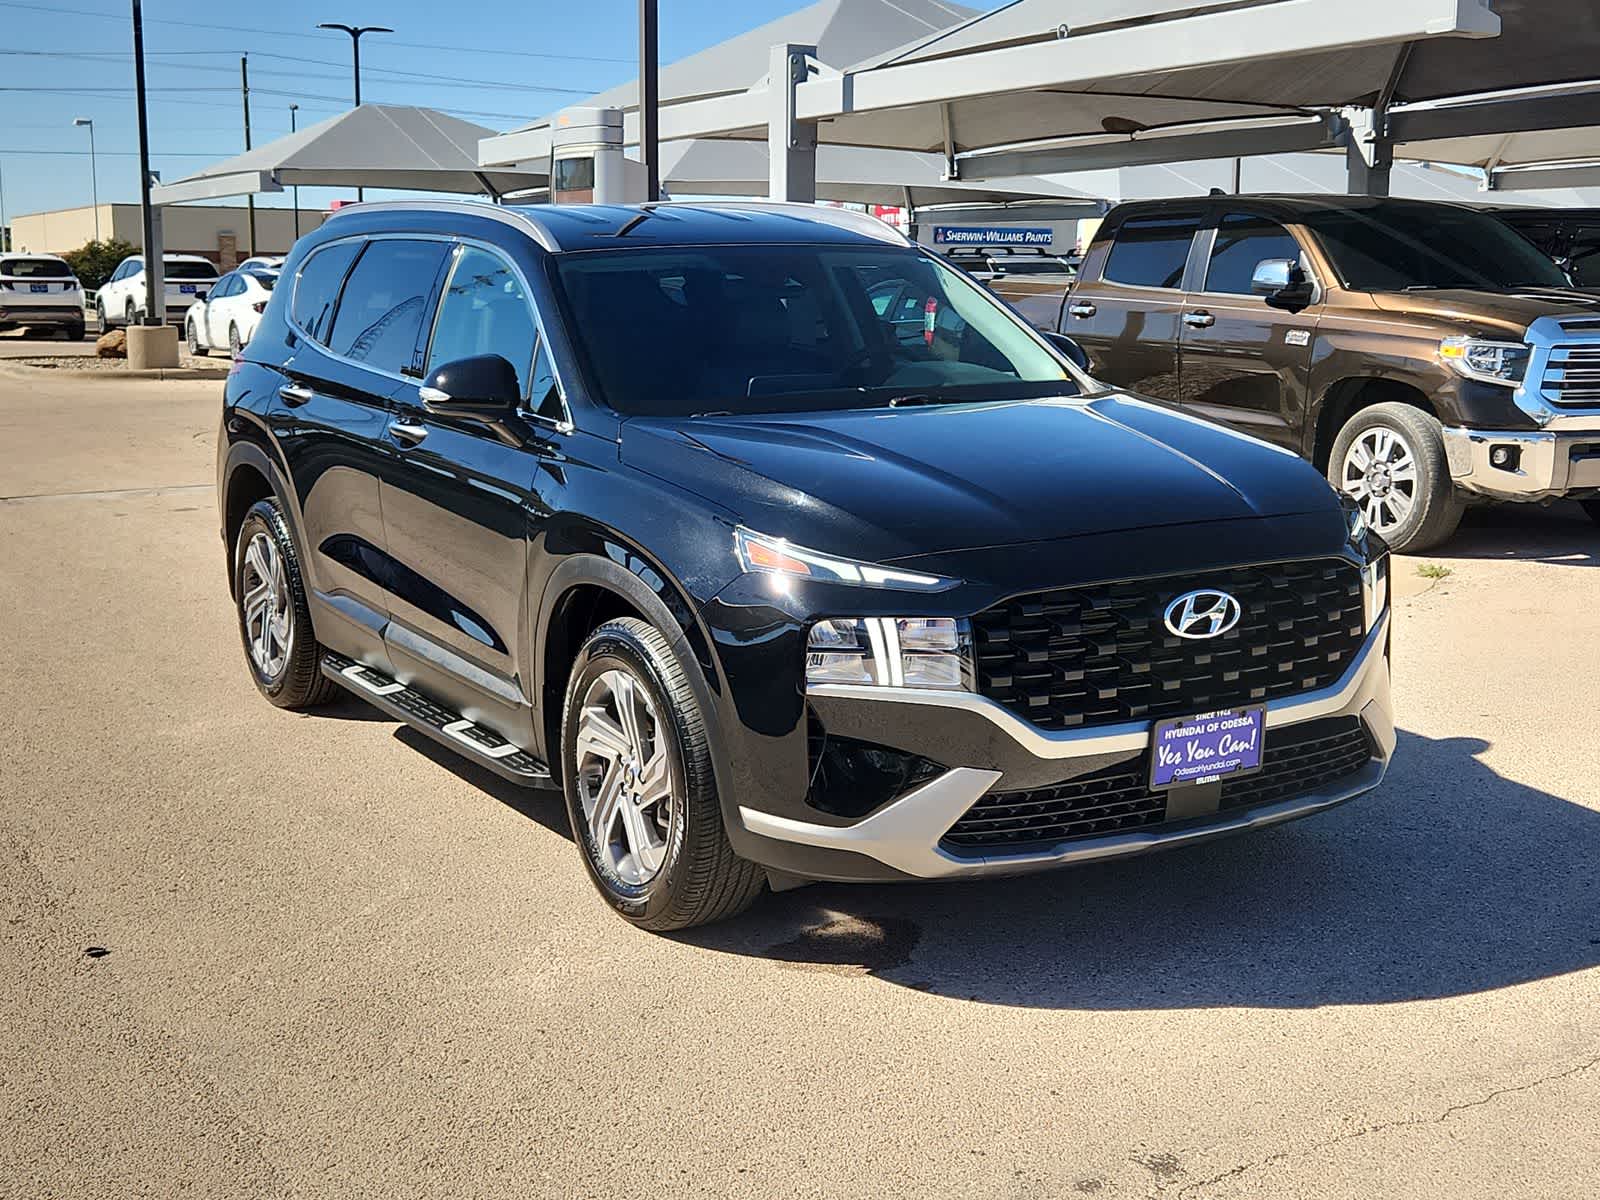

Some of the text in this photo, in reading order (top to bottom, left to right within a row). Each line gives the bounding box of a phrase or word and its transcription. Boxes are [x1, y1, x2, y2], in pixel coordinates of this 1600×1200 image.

[945, 230, 1052, 243] SHERWIN-WILLIAMS PAINTS
[1195, 712, 1215, 721] SINCE
[1165, 715, 1254, 740] HYUNDAI OF ODESSA
[1158, 728, 1257, 767] Yes You Can!
